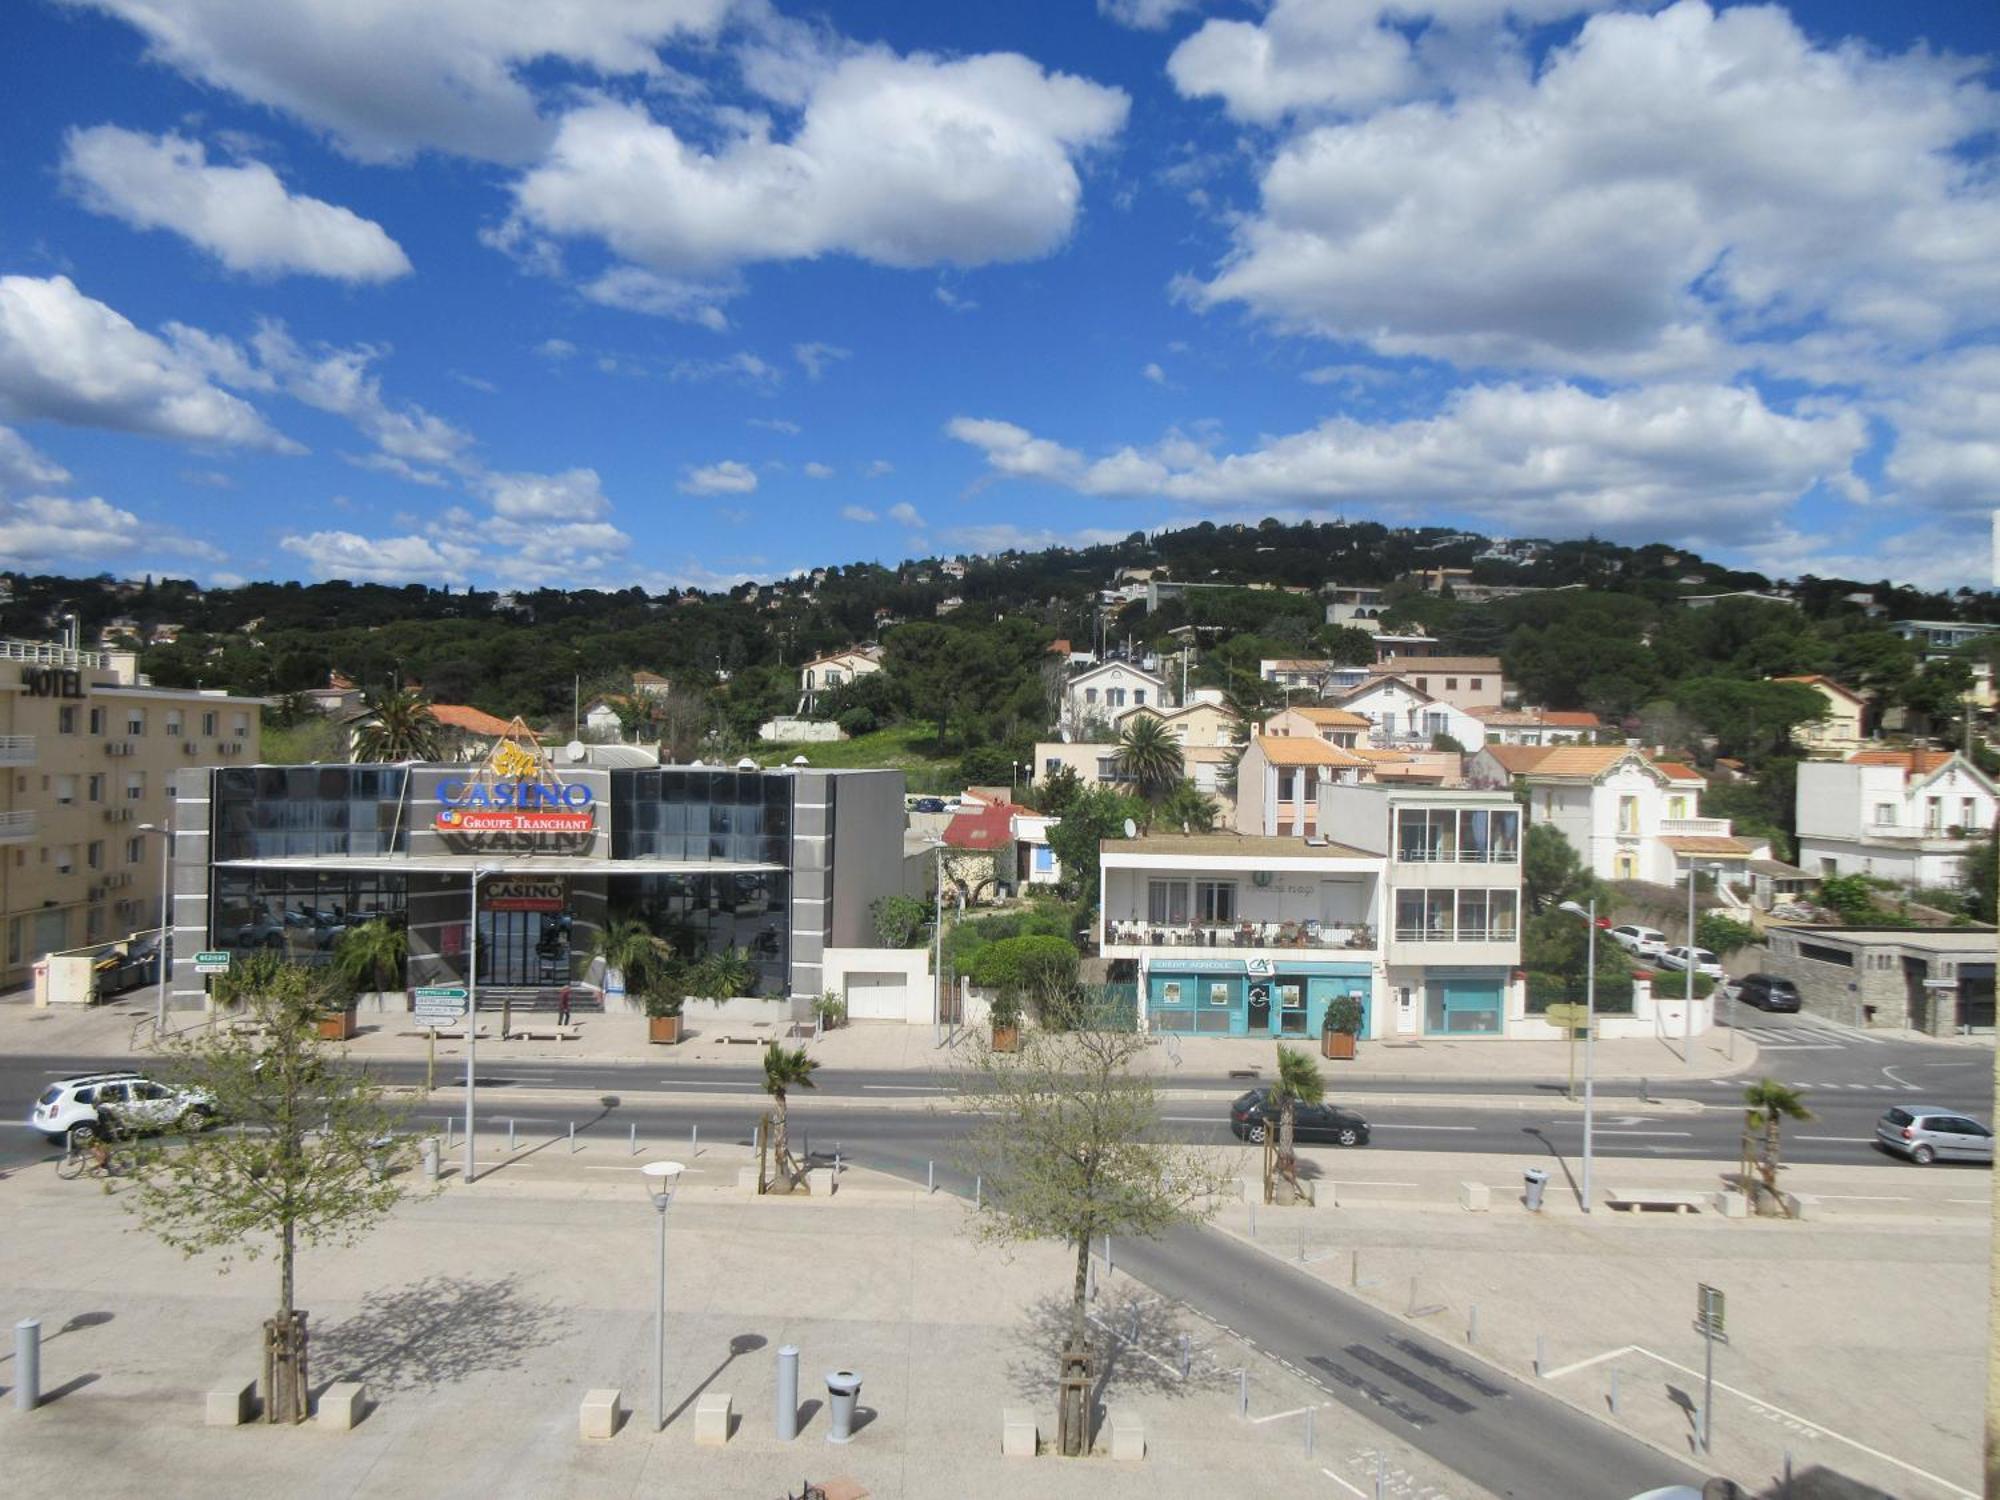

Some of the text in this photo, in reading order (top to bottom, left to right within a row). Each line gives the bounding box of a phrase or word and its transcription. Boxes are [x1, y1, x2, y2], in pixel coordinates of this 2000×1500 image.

[435, 777, 593, 808] CASINO
[463, 816, 588, 830] GROUPE TRANCHANT
[487, 884, 561, 897] CASINO
